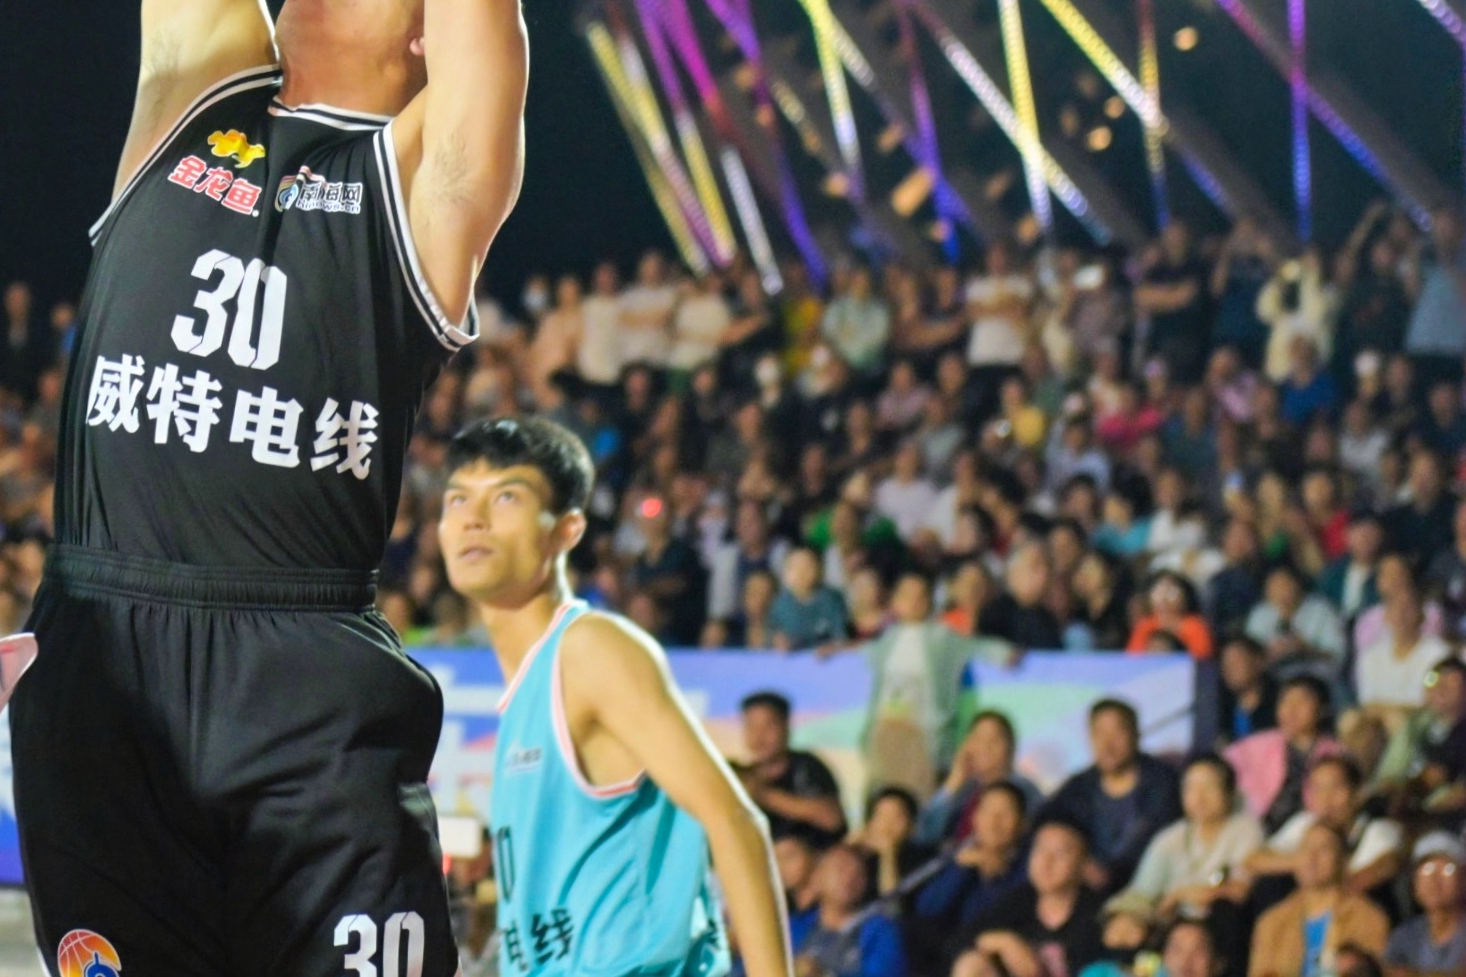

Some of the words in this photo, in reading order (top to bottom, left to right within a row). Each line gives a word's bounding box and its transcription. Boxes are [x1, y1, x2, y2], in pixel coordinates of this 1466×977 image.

[168, 155, 262, 215] 金龙鱼
[170, 248, 287, 370] 30
[86, 353, 379, 480] 威特电线
[334, 911, 425, 977] 30
